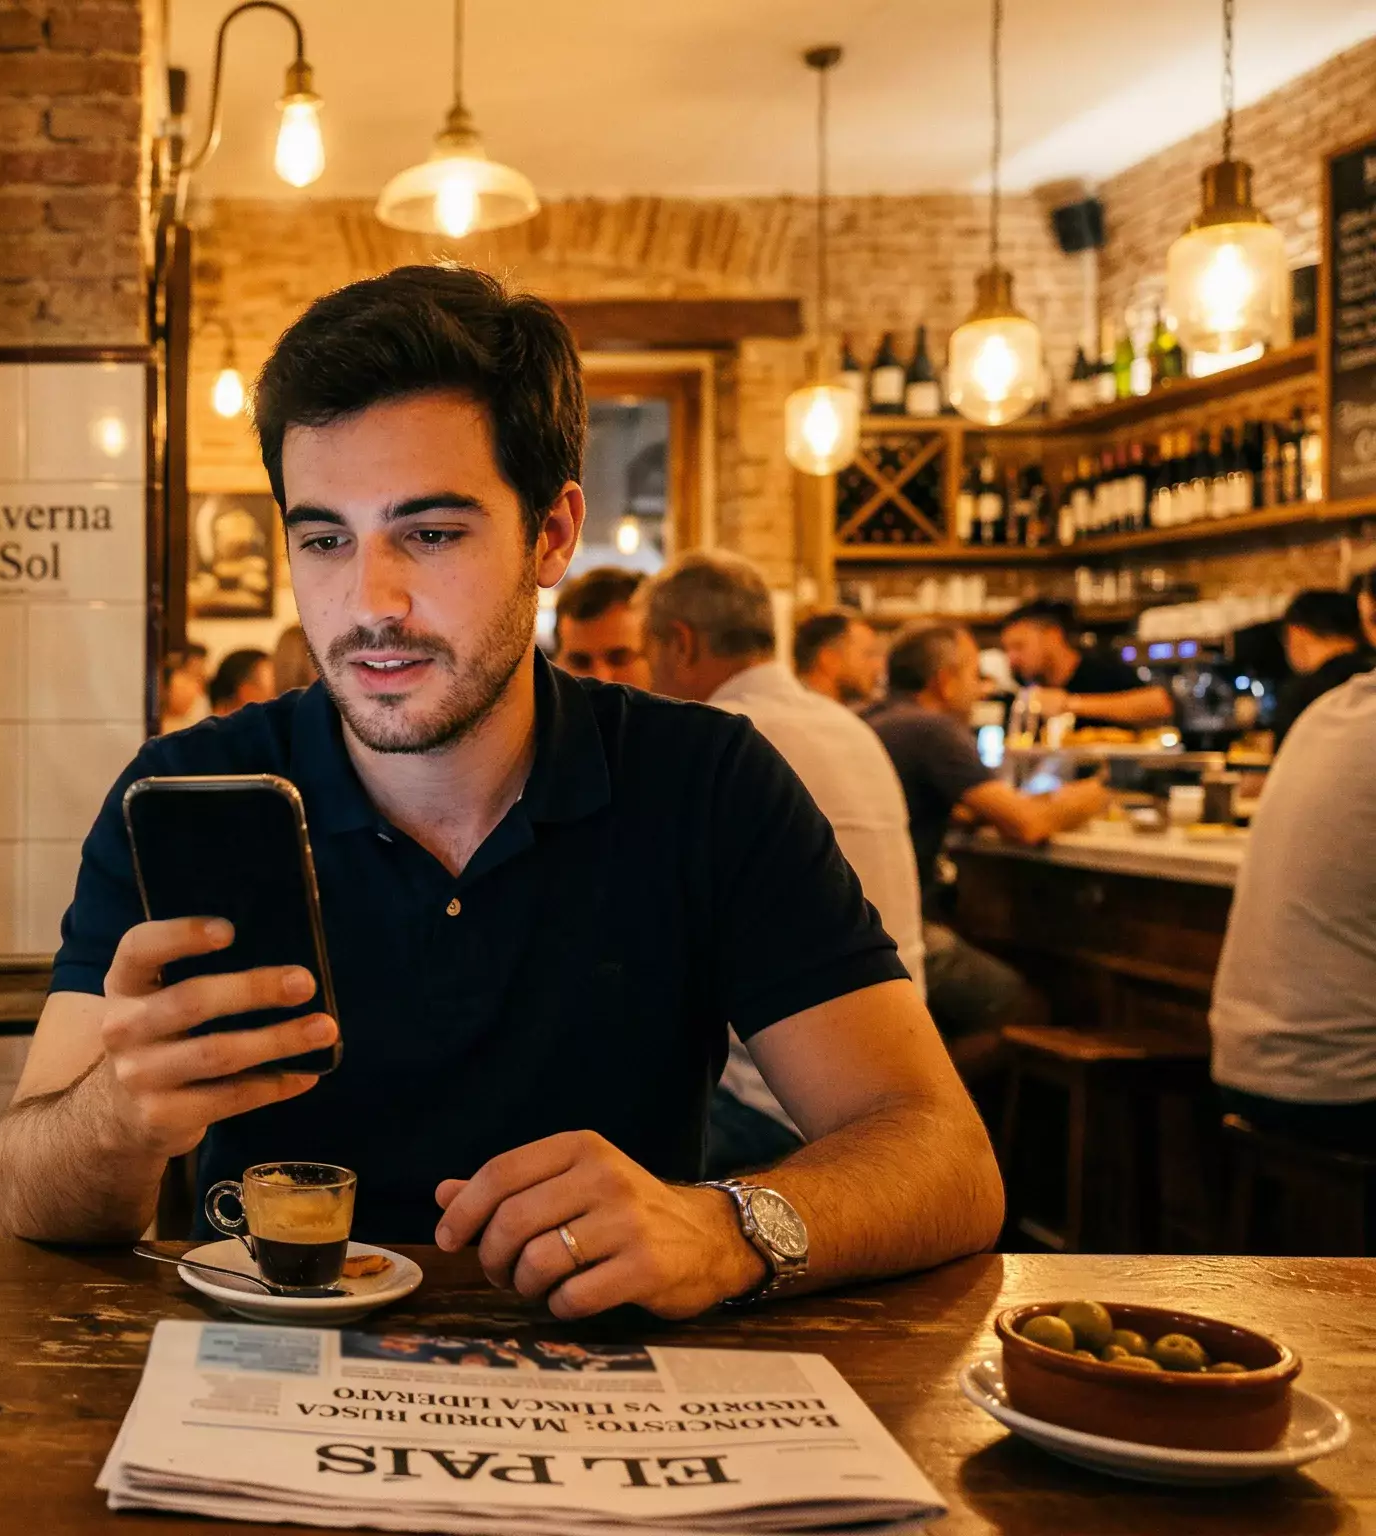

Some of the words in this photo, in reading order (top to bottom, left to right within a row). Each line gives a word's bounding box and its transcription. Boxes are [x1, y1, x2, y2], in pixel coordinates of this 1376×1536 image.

[333, 1386, 491, 1410] LIDERATO
[296, 1402, 407, 1423] BUSCA
[420, 1411, 570, 1433] MADRID
[585, 1414, 840, 1432] BALONCESTO:
[315, 1443, 565, 1486] PAÍS
[581, 1454, 741, 1488] EL
